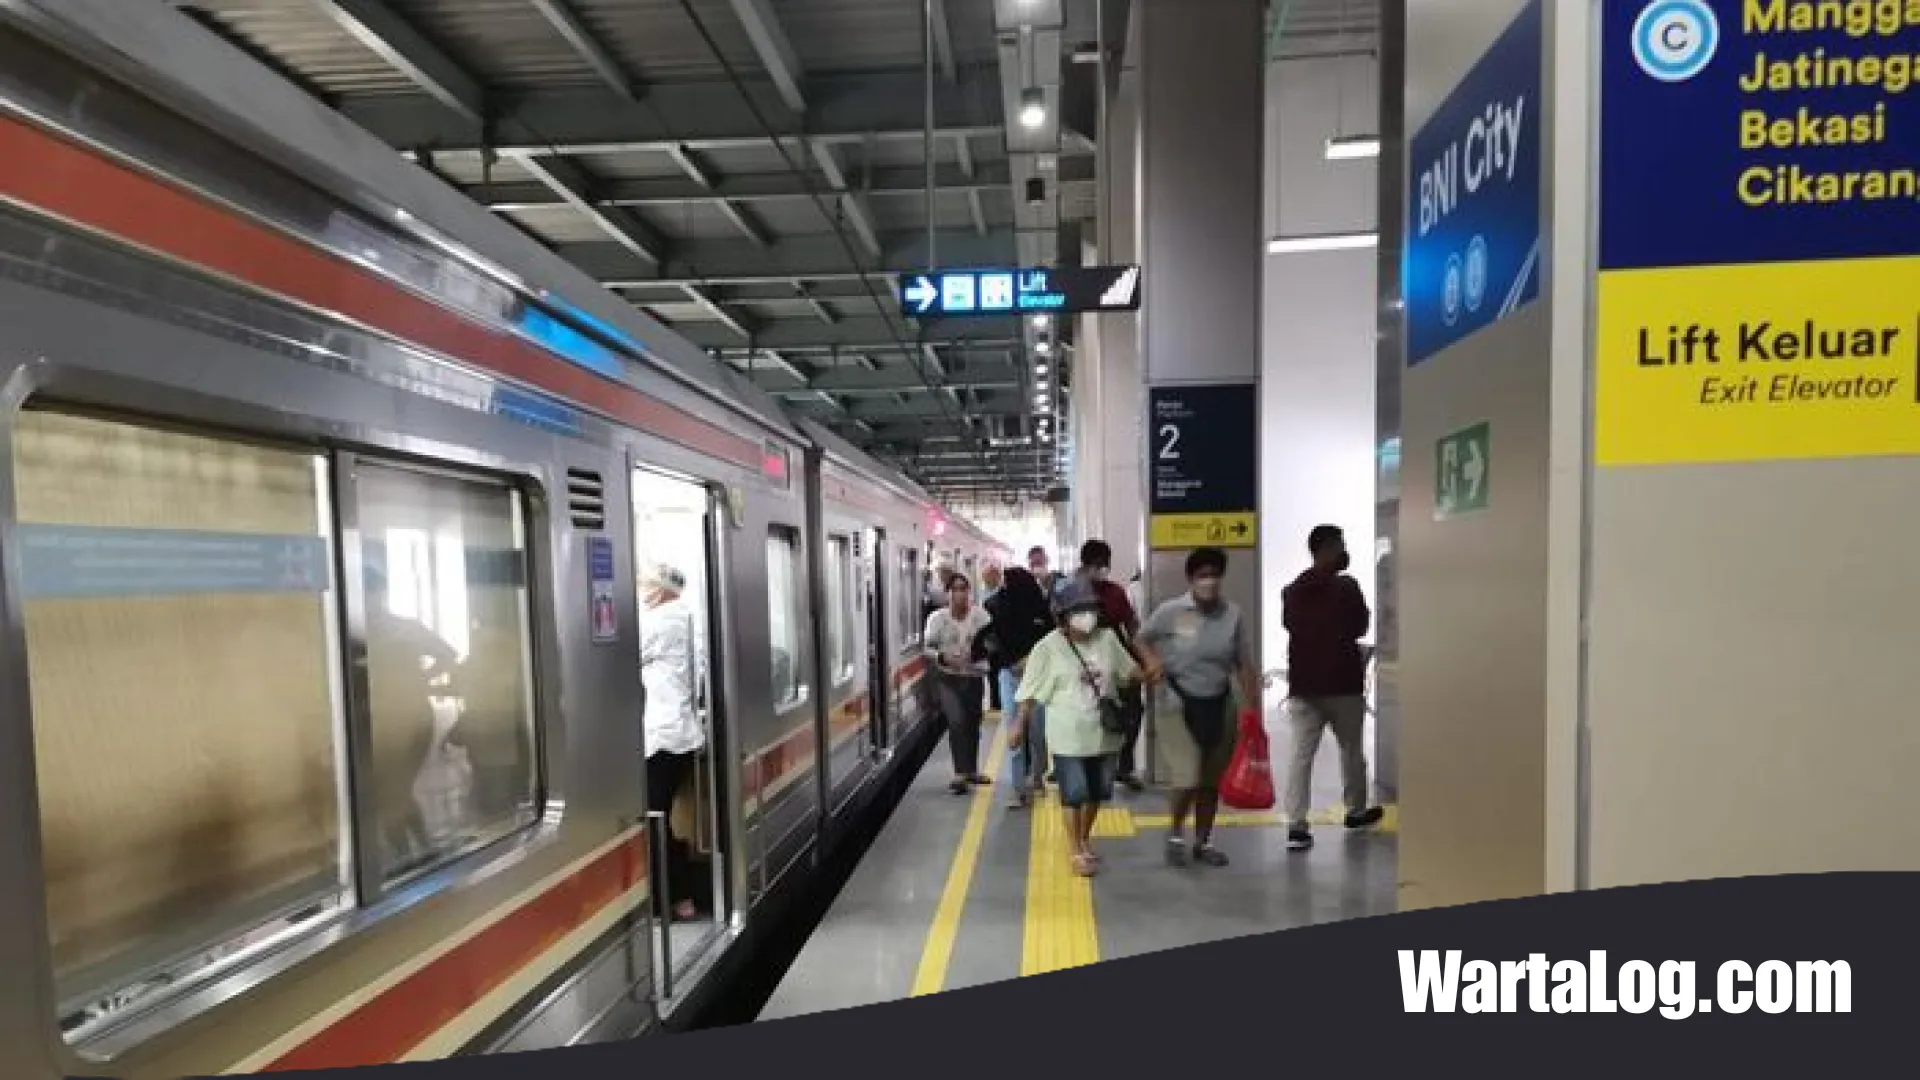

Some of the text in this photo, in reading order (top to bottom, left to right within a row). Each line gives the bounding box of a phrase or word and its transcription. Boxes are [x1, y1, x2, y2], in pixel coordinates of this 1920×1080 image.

[1661, 21, 1688, 51] C
[1740, 47, 1920, 93] Jatineg
[1741, 101, 1885, 148] Bekasi
[1420, 96, 1523, 236] BNI City
[1740, 164, 1920, 206] Cikaran
[1638, 318, 1899, 366] Lift Keluar
[1700, 372, 1898, 403] Exit Elevator
[1159, 424, 1181, 459] 2
